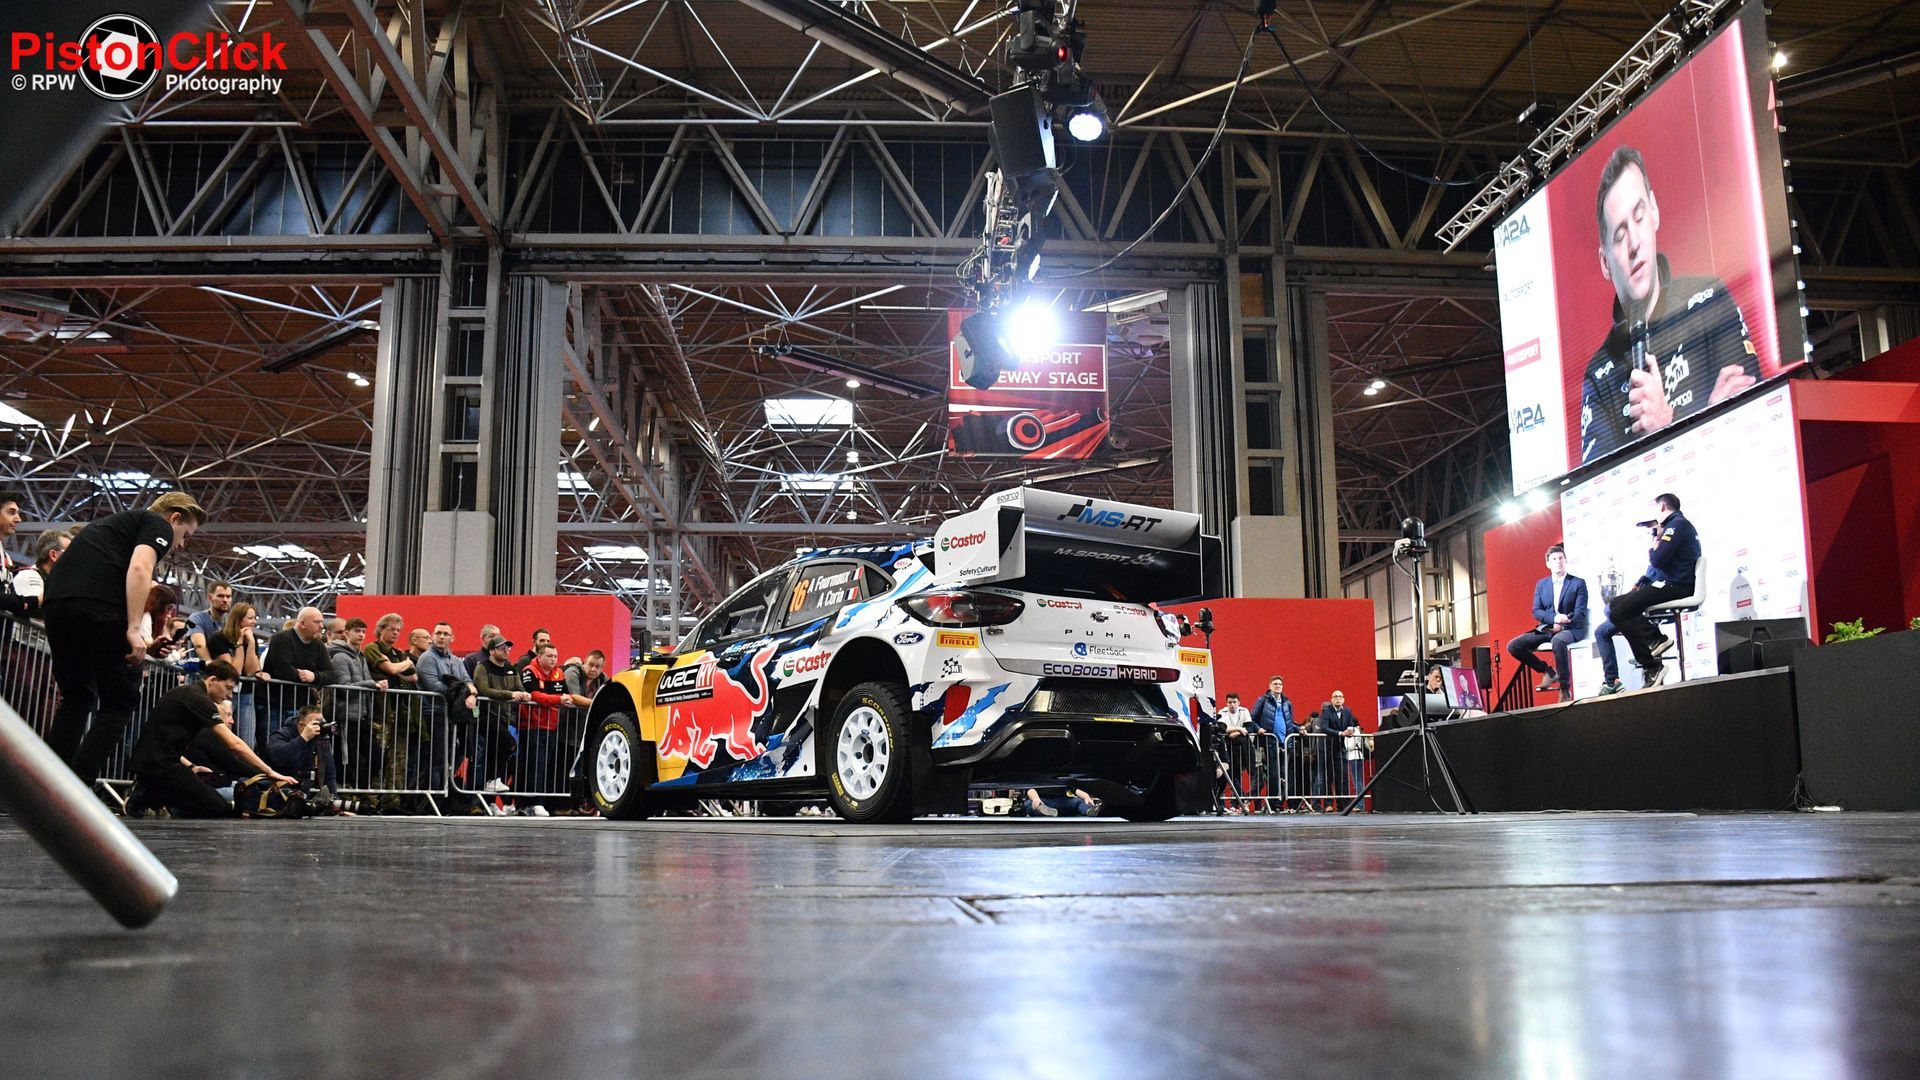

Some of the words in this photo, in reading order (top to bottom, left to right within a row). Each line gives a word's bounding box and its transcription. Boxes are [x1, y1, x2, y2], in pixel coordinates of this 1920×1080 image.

[1048, 372, 1099, 385] STAGE
[1076, 507, 1163, 533] MS-RT
[950, 530, 986, 550] Castrol
[1054, 547, 1131, 562] M-SPORT
[789, 579, 809, 613] 16
[1047, 599, 1083, 610] Castrol
[896, 632, 919, 644] Ford
[940, 634, 976, 646] PIRELLI
[1064, 628, 1131, 640] PUMA
[795, 650, 833, 674] Castr
[1118, 667, 1157, 681] HYBRID
